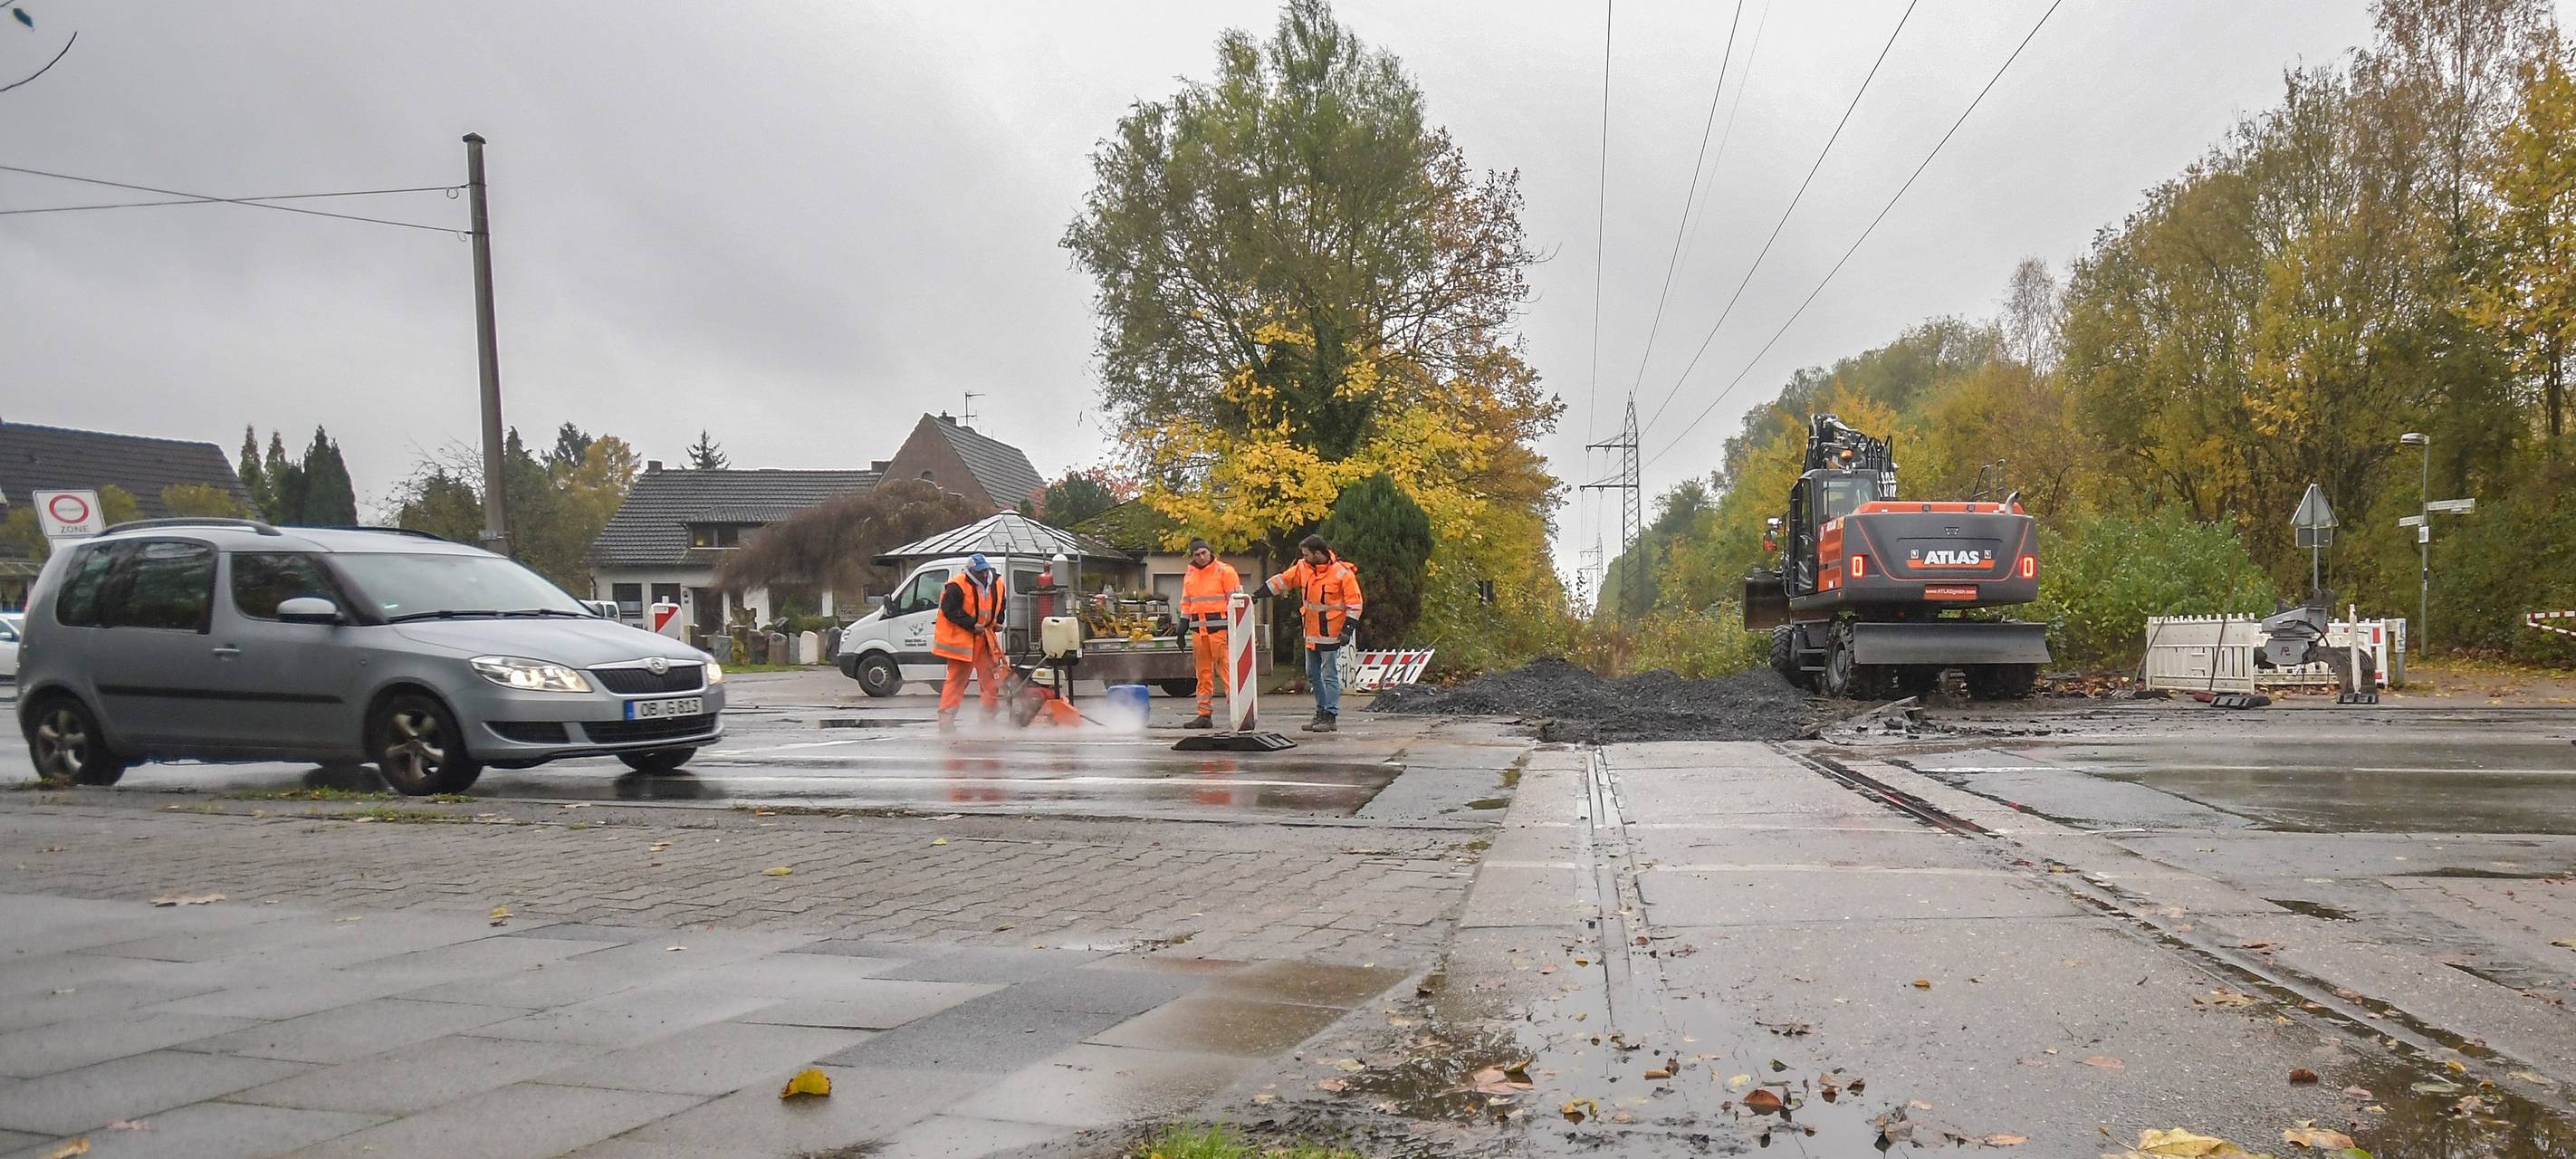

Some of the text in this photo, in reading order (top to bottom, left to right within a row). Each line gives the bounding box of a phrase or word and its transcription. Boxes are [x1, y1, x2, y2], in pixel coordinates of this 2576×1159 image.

[60, 525, 89, 534] ZONE
[1923, 550, 1980, 565] ATLAS
[641, 702, 657, 717] OB
[677, 699, 698, 714] 813
